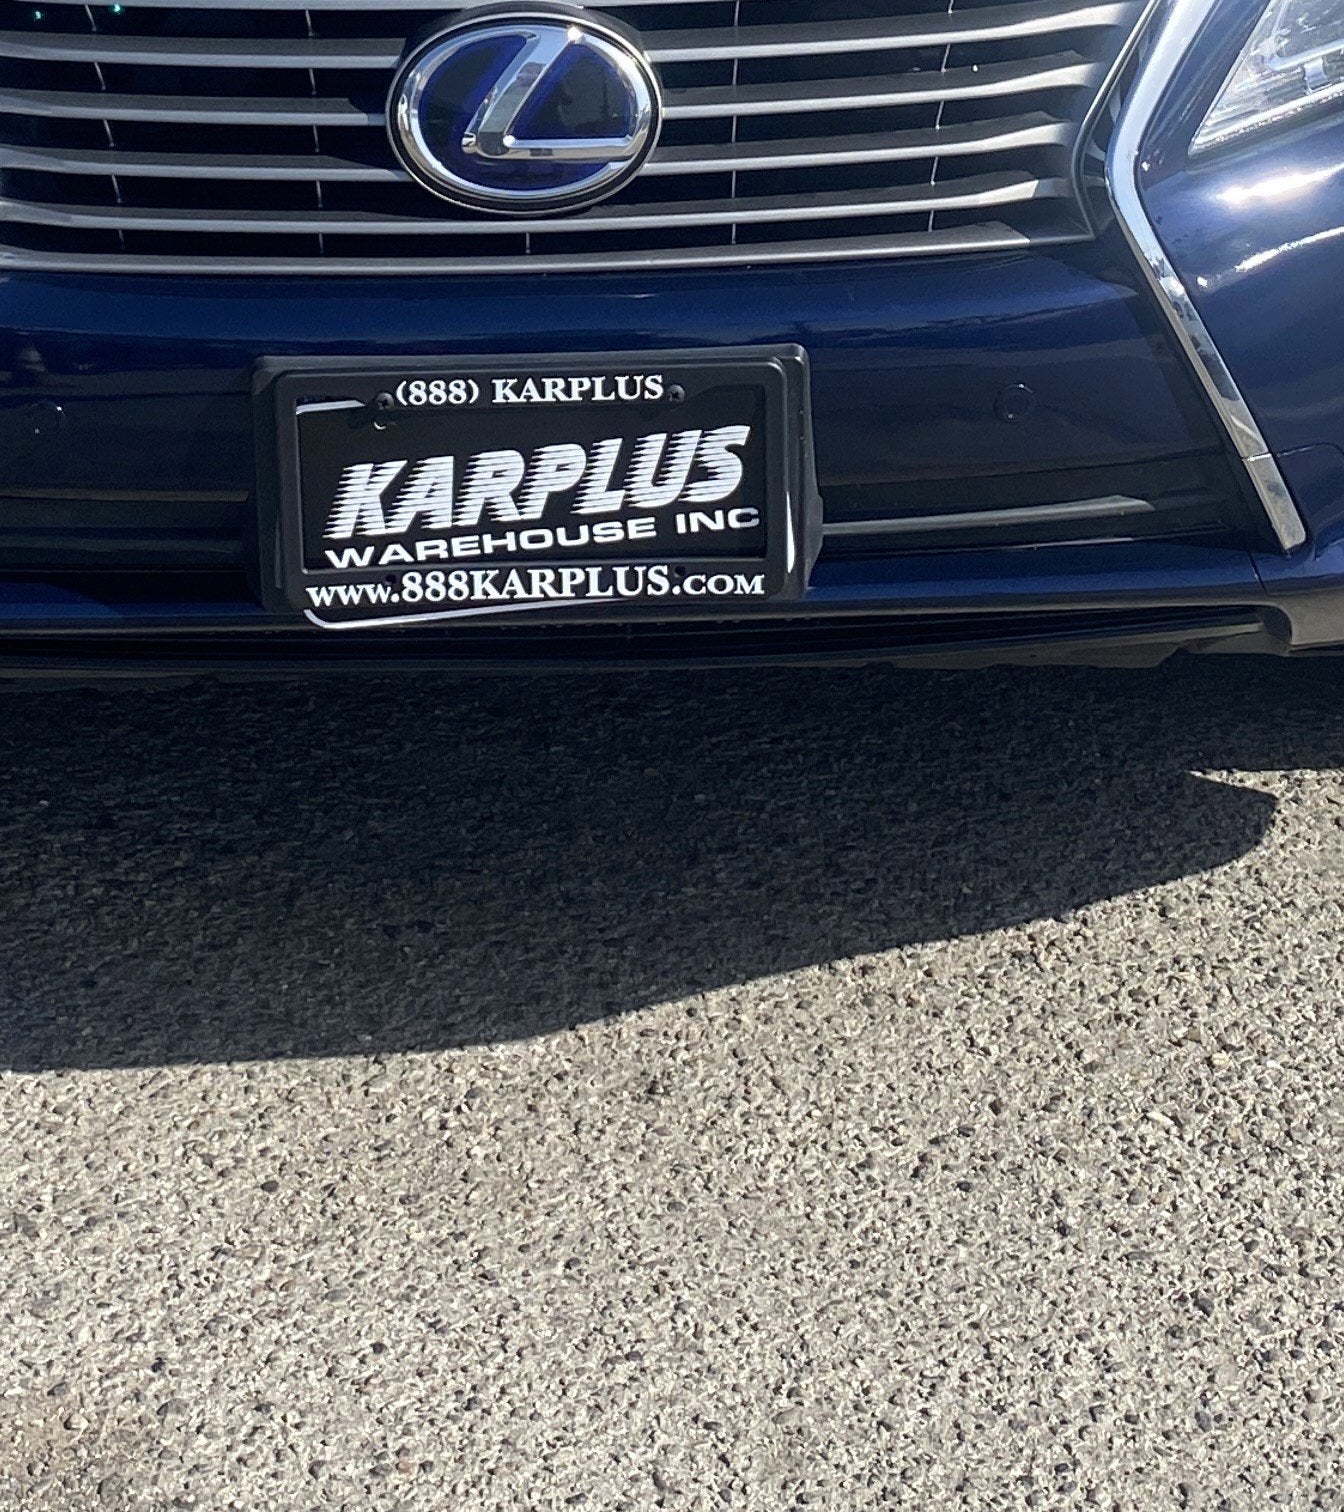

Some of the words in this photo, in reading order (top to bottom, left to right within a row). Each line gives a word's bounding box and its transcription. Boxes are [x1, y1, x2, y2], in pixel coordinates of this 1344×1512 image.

[396, 378, 480, 407] (888)
[492, 374, 664, 404] KARPLUS
[322, 424, 752, 540] KARPLUS
[324, 516, 657, 569] WAREHOUSE
[675, 506, 760, 535] INC
